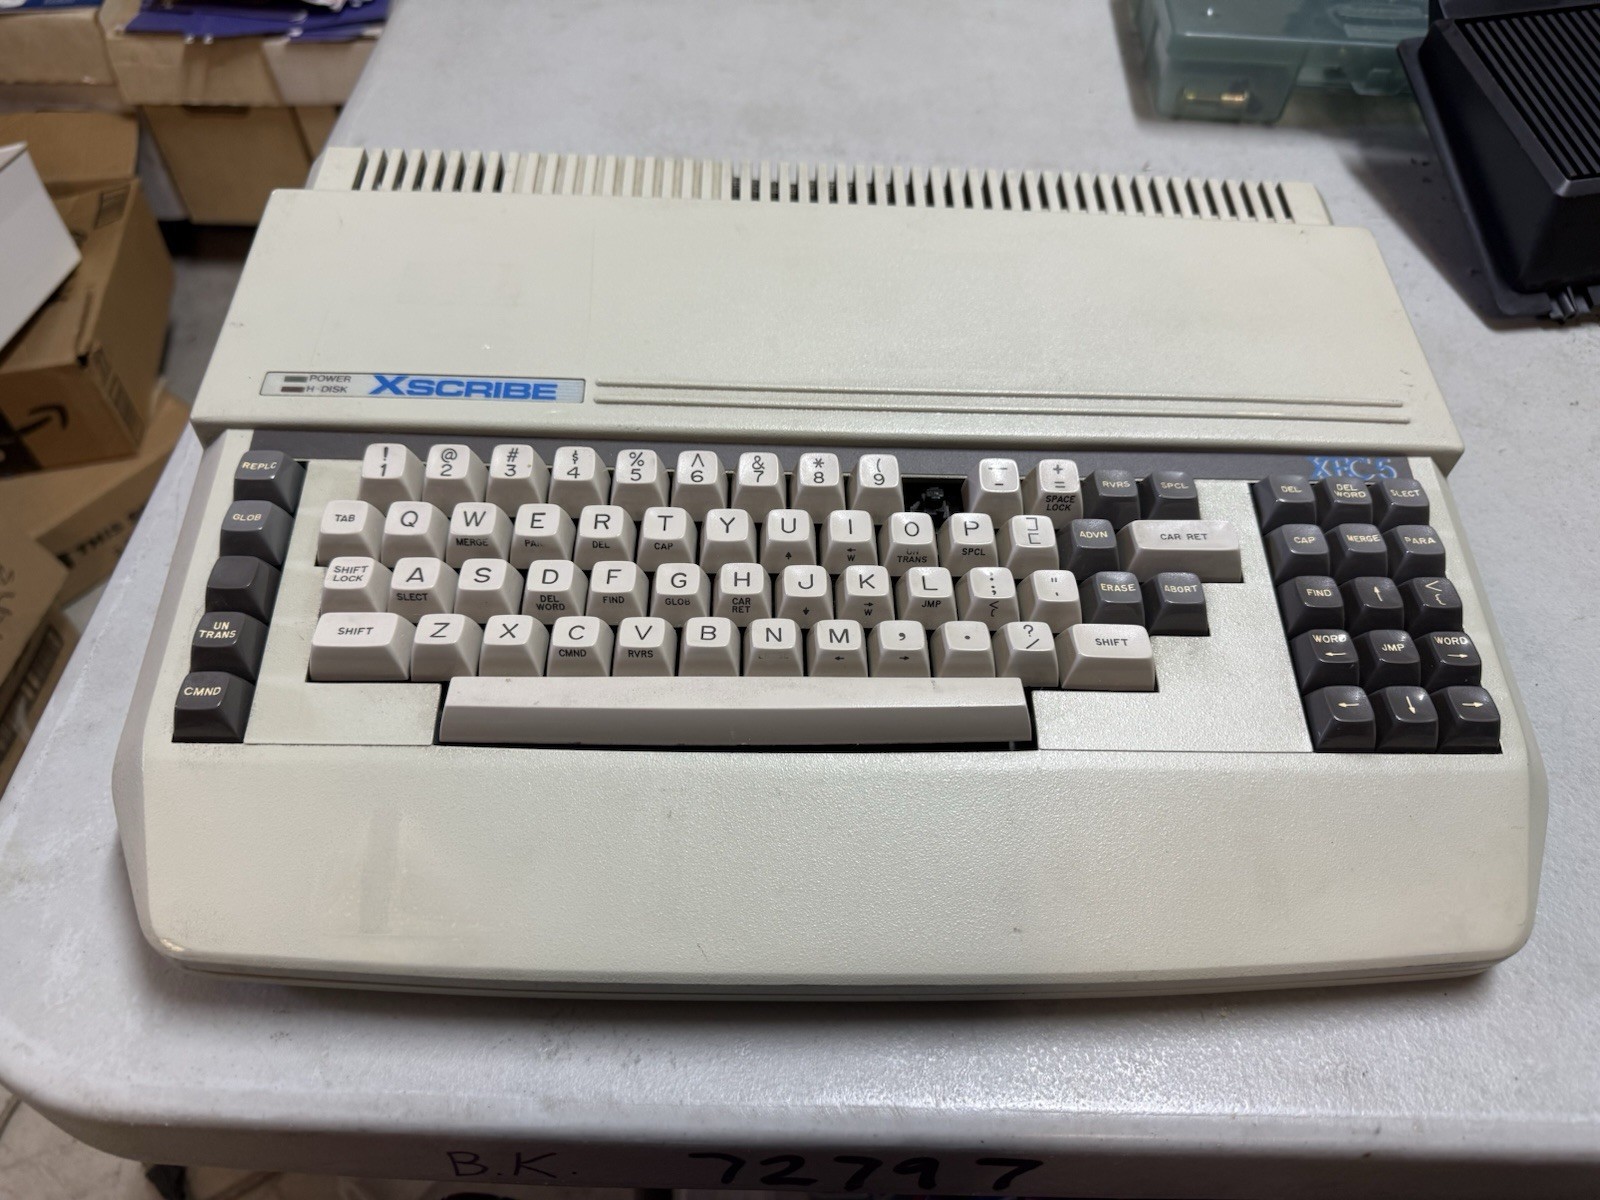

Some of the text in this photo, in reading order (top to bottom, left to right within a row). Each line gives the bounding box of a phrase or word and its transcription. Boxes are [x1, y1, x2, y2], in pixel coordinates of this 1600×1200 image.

[309, 374, 352, 383] POWER
[369, 374, 558, 400] XSCRIBE
[383, 446, 389, 461] !
[440, 448, 458, 463] @
[507, 448, 519, 462] #
[572, 450, 579, 464] $
[629, 451, 645, 467] %
[241, 460, 277, 470] REPLC
[751, 455, 766, 471] &
[380, 463, 387, 477] 1
[439, 463, 452, 476] 2
[504, 464, 517, 477] 3
[566, 466, 581, 479] 4
[630, 468, 642, 481] 5
[1053, 464, 1064, 474] +
[690, 470, 704, 483] 6
[753, 470, 765, 483] 7
[813, 471, 825, 484] 8
[873, 473, 886, 486] 9
[1102, 480, 1131, 488] RVRS
[1160, 480, 1190, 491] SPCL
[1280, 485, 1302, 493] DEL
[1336, 483, 1358, 492] DEL
[1045, 494, 1076, 504] SPACE
[1334, 490, 1367, 500] WORD
[1390, 489, 1420, 498] SLECT
[1046, 503, 1072, 512] LOCK
[232, 513, 262, 522] GLOB
[335, 513, 356, 523] TAB
[400, 510, 419, 528] Q
[463, 510, 487, 527] W
[530, 512, 546, 529] E
[593, 513, 611, 530] R
[657, 515, 674, 531] T
[719, 517, 736, 534] Y
[781, 517, 797, 534] U
[904, 521, 920, 537] O
[963, 521, 980, 537] P
[1079, 530, 1108, 539] ADVN
[1159, 533, 1208, 541] CAR RET
[1293, 536, 1316, 544] CAP
[1346, 534, 1381, 543] MERGE
[455, 537, 489, 547] MERGE
[592, 540, 611, 549] DEL
[1404, 536, 1436, 545] PARA
[653, 542, 674, 551] CAP
[961, 547, 986, 557] SPCL
[846, 554, 856, 562] W
[897, 555, 928, 564] TRANS
[333, 565, 369, 574] SHIFT
[405, 567, 424, 583] A
[473, 567, 492, 583] S
[332, 574, 364, 582] LOCK
[541, 568, 559, 585] D
[606, 568, 622, 585] F
[670, 572, 687, 589] G
[733, 571, 751, 587] H
[797, 573, 814, 590] J
[859, 573, 876, 590] K
[921, 575, 939, 591] L
[1100, 582, 1136, 592] ERASE
[1164, 584, 1198, 593] ABORT
[396, 592, 428, 602] SLECT
[1306, 588, 1332, 597] FIND
[539, 594, 560, 604] DEL
[602, 595, 625, 604] FIND
[731, 597, 751, 606] CAR
[921, 600, 942, 608] JMP
[535, 603, 566, 612] WORD
[731, 605, 751, 614] RET
[863, 608, 873, 616] W
[213, 621, 230, 630] UN
[337, 626, 374, 636] SHIFT
[429, 622, 450, 638] Z
[499, 623, 519, 639] X
[1022, 624, 1034, 637] ?
[199, 629, 236, 639] TRANS
[568, 624, 586, 641] C
[634, 625, 653, 641] V
[700, 625, 717, 641] B
[765, 627, 782, 643] N
[828, 628, 850, 644] M
[1025, 638, 1040, 650] /
[1094, 637, 1128, 647] SHIFT
[1433, 635, 1468, 647] WORD
[558, 648, 587, 658] CMND
[1381, 643, 1405, 652] JMP
[627, 649, 654, 659] RVRS
[183, 686, 222, 696] CMND
